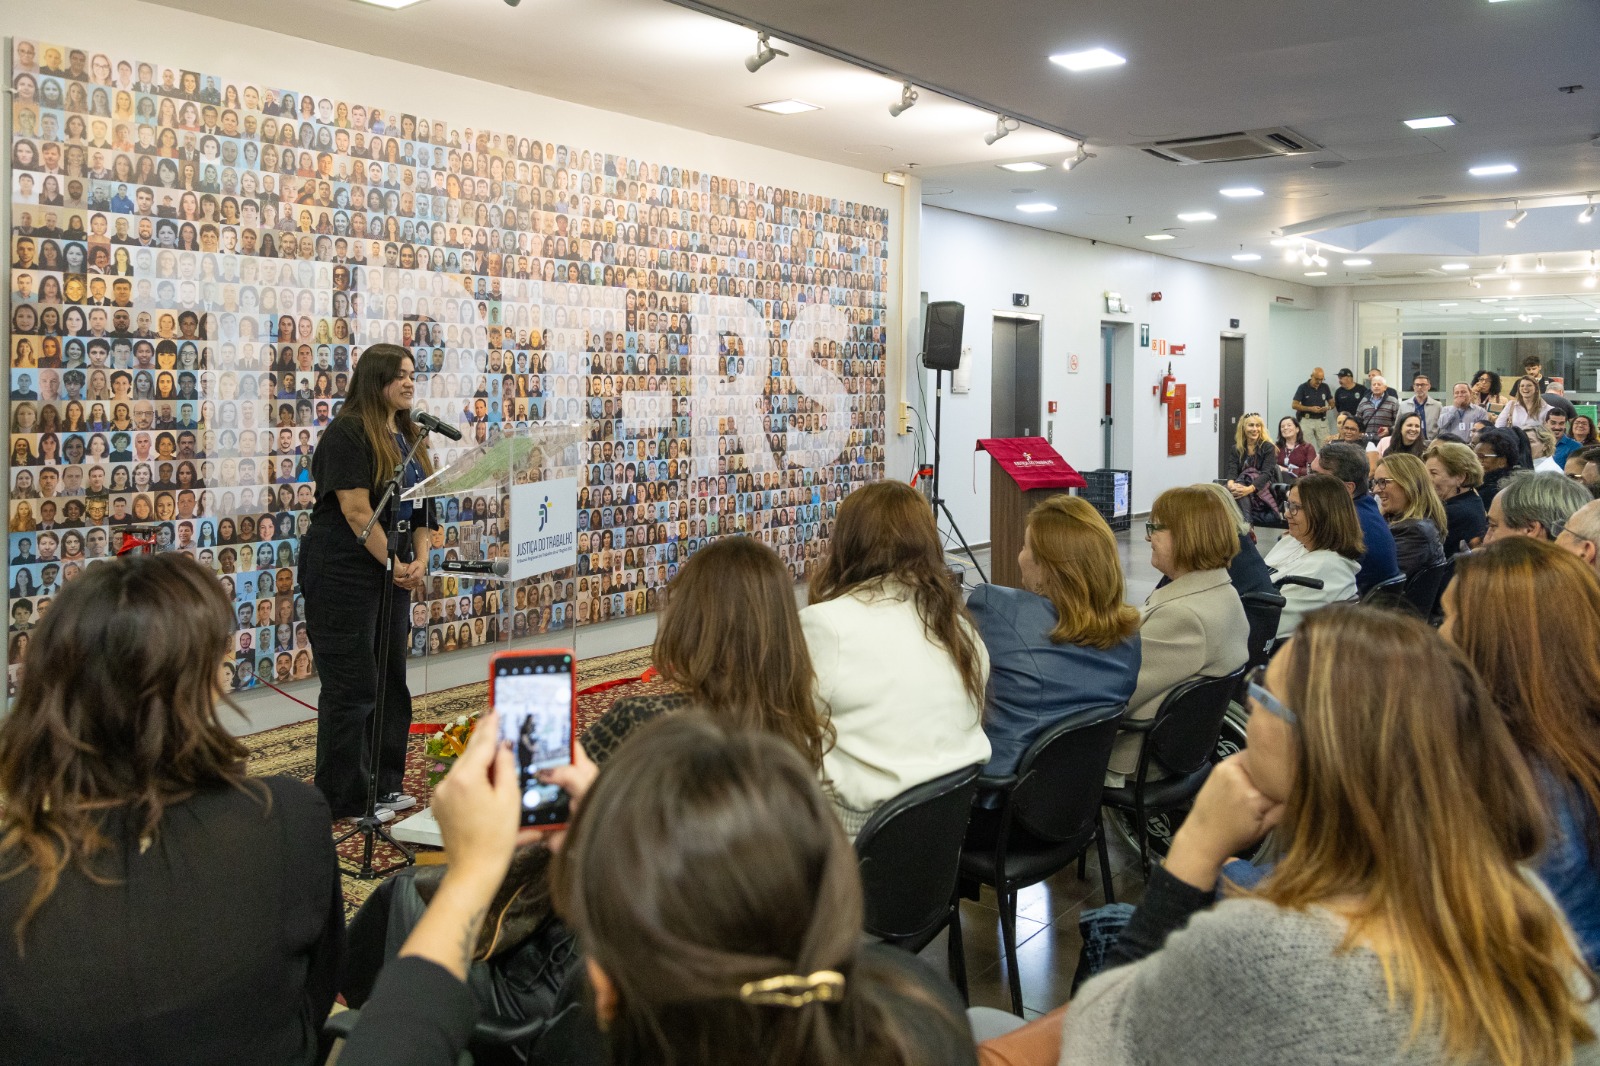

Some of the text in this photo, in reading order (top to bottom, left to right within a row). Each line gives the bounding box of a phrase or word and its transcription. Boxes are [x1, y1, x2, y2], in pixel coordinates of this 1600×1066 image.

[516, 531, 573, 556] JUSTIÇA DO TRABALHO
